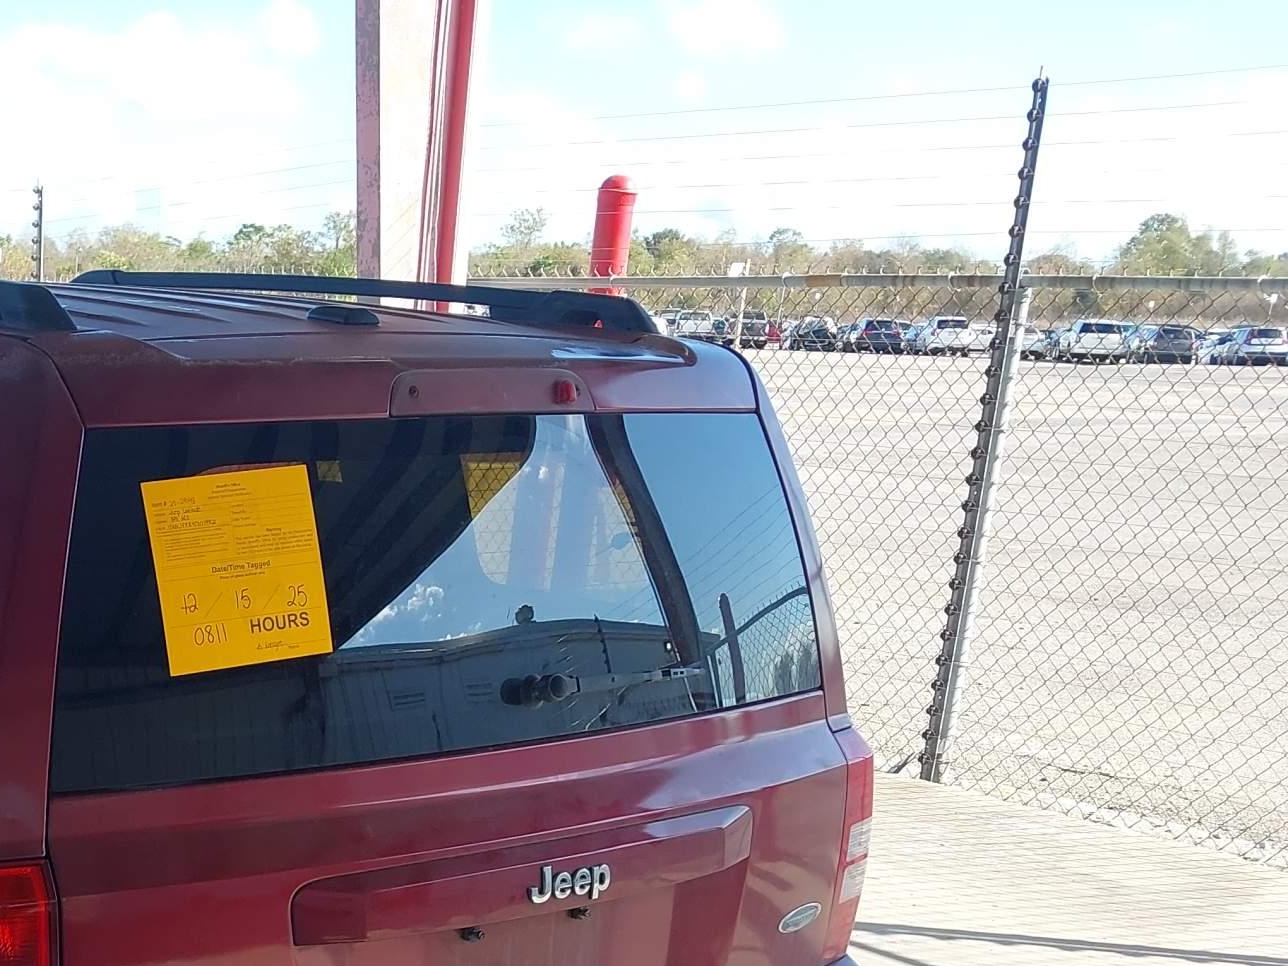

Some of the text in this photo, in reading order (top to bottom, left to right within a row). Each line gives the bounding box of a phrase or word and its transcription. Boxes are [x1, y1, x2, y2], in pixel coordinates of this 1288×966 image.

[247, 560, 271, 570] Tagged
[180, 592, 199, 615] 12
[235, 588, 251, 609] 15
[287, 584, 308, 607] 25
[194, 622, 228, 646] 0811
[250, 612, 310, 635] HOURS
[530, 863, 611, 904] Jeep
